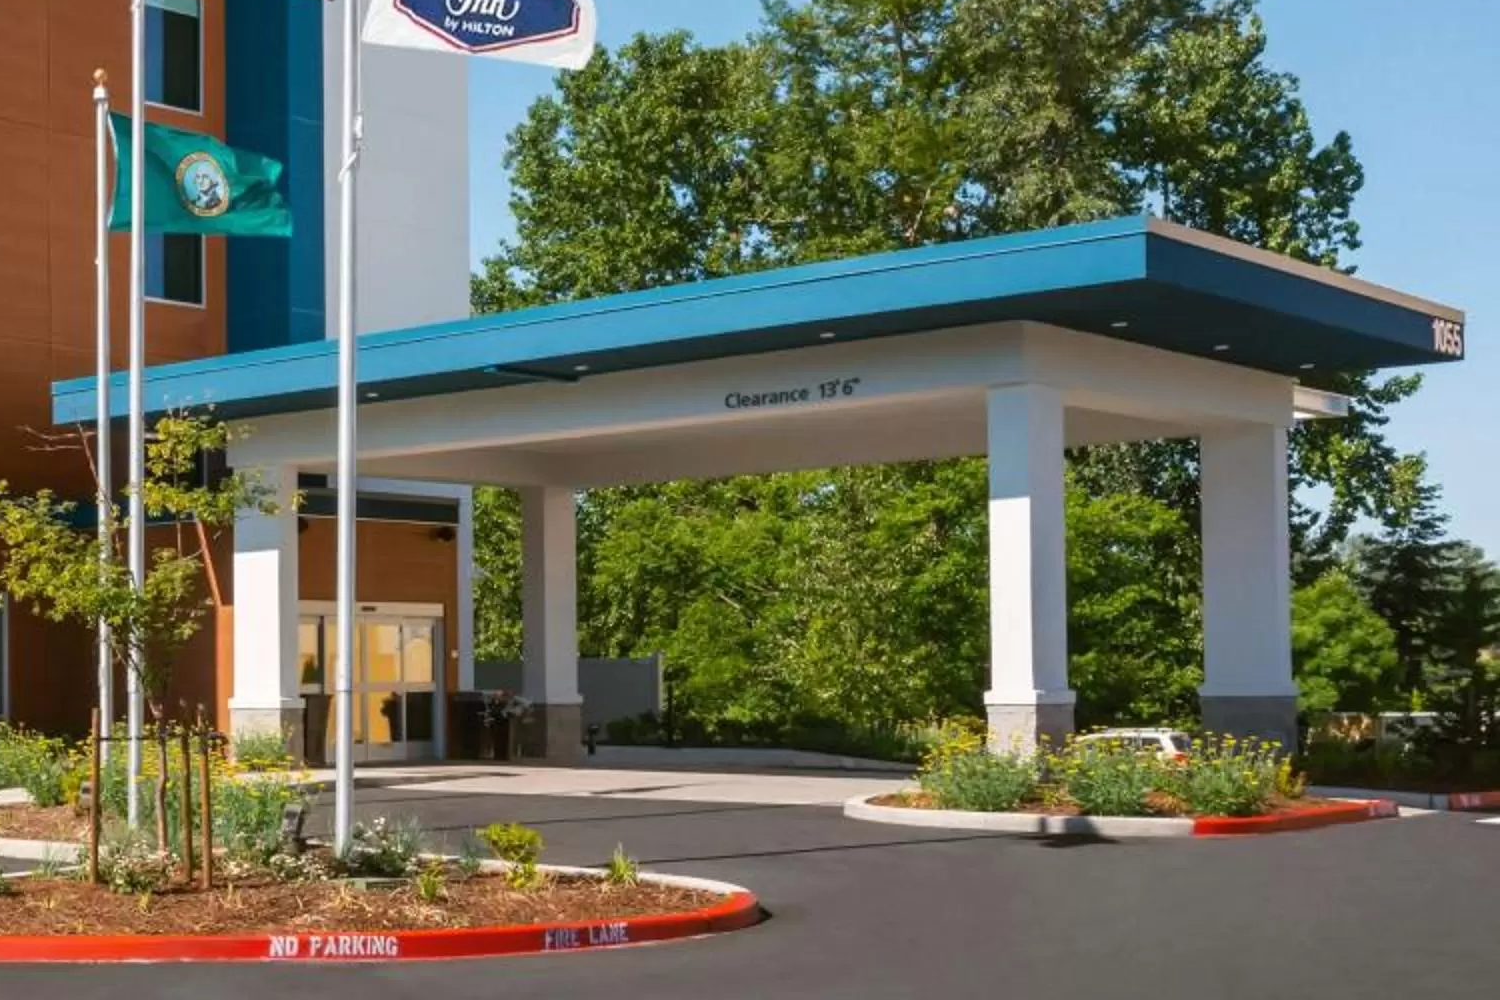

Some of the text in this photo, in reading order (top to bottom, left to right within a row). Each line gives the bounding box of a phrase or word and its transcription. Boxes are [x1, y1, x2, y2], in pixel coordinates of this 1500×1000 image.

[462, 20, 515, 37] HILTON
[724, 388, 810, 408] Clearance
[269, 922, 629, 957] NO PARKING FIRE LANE
